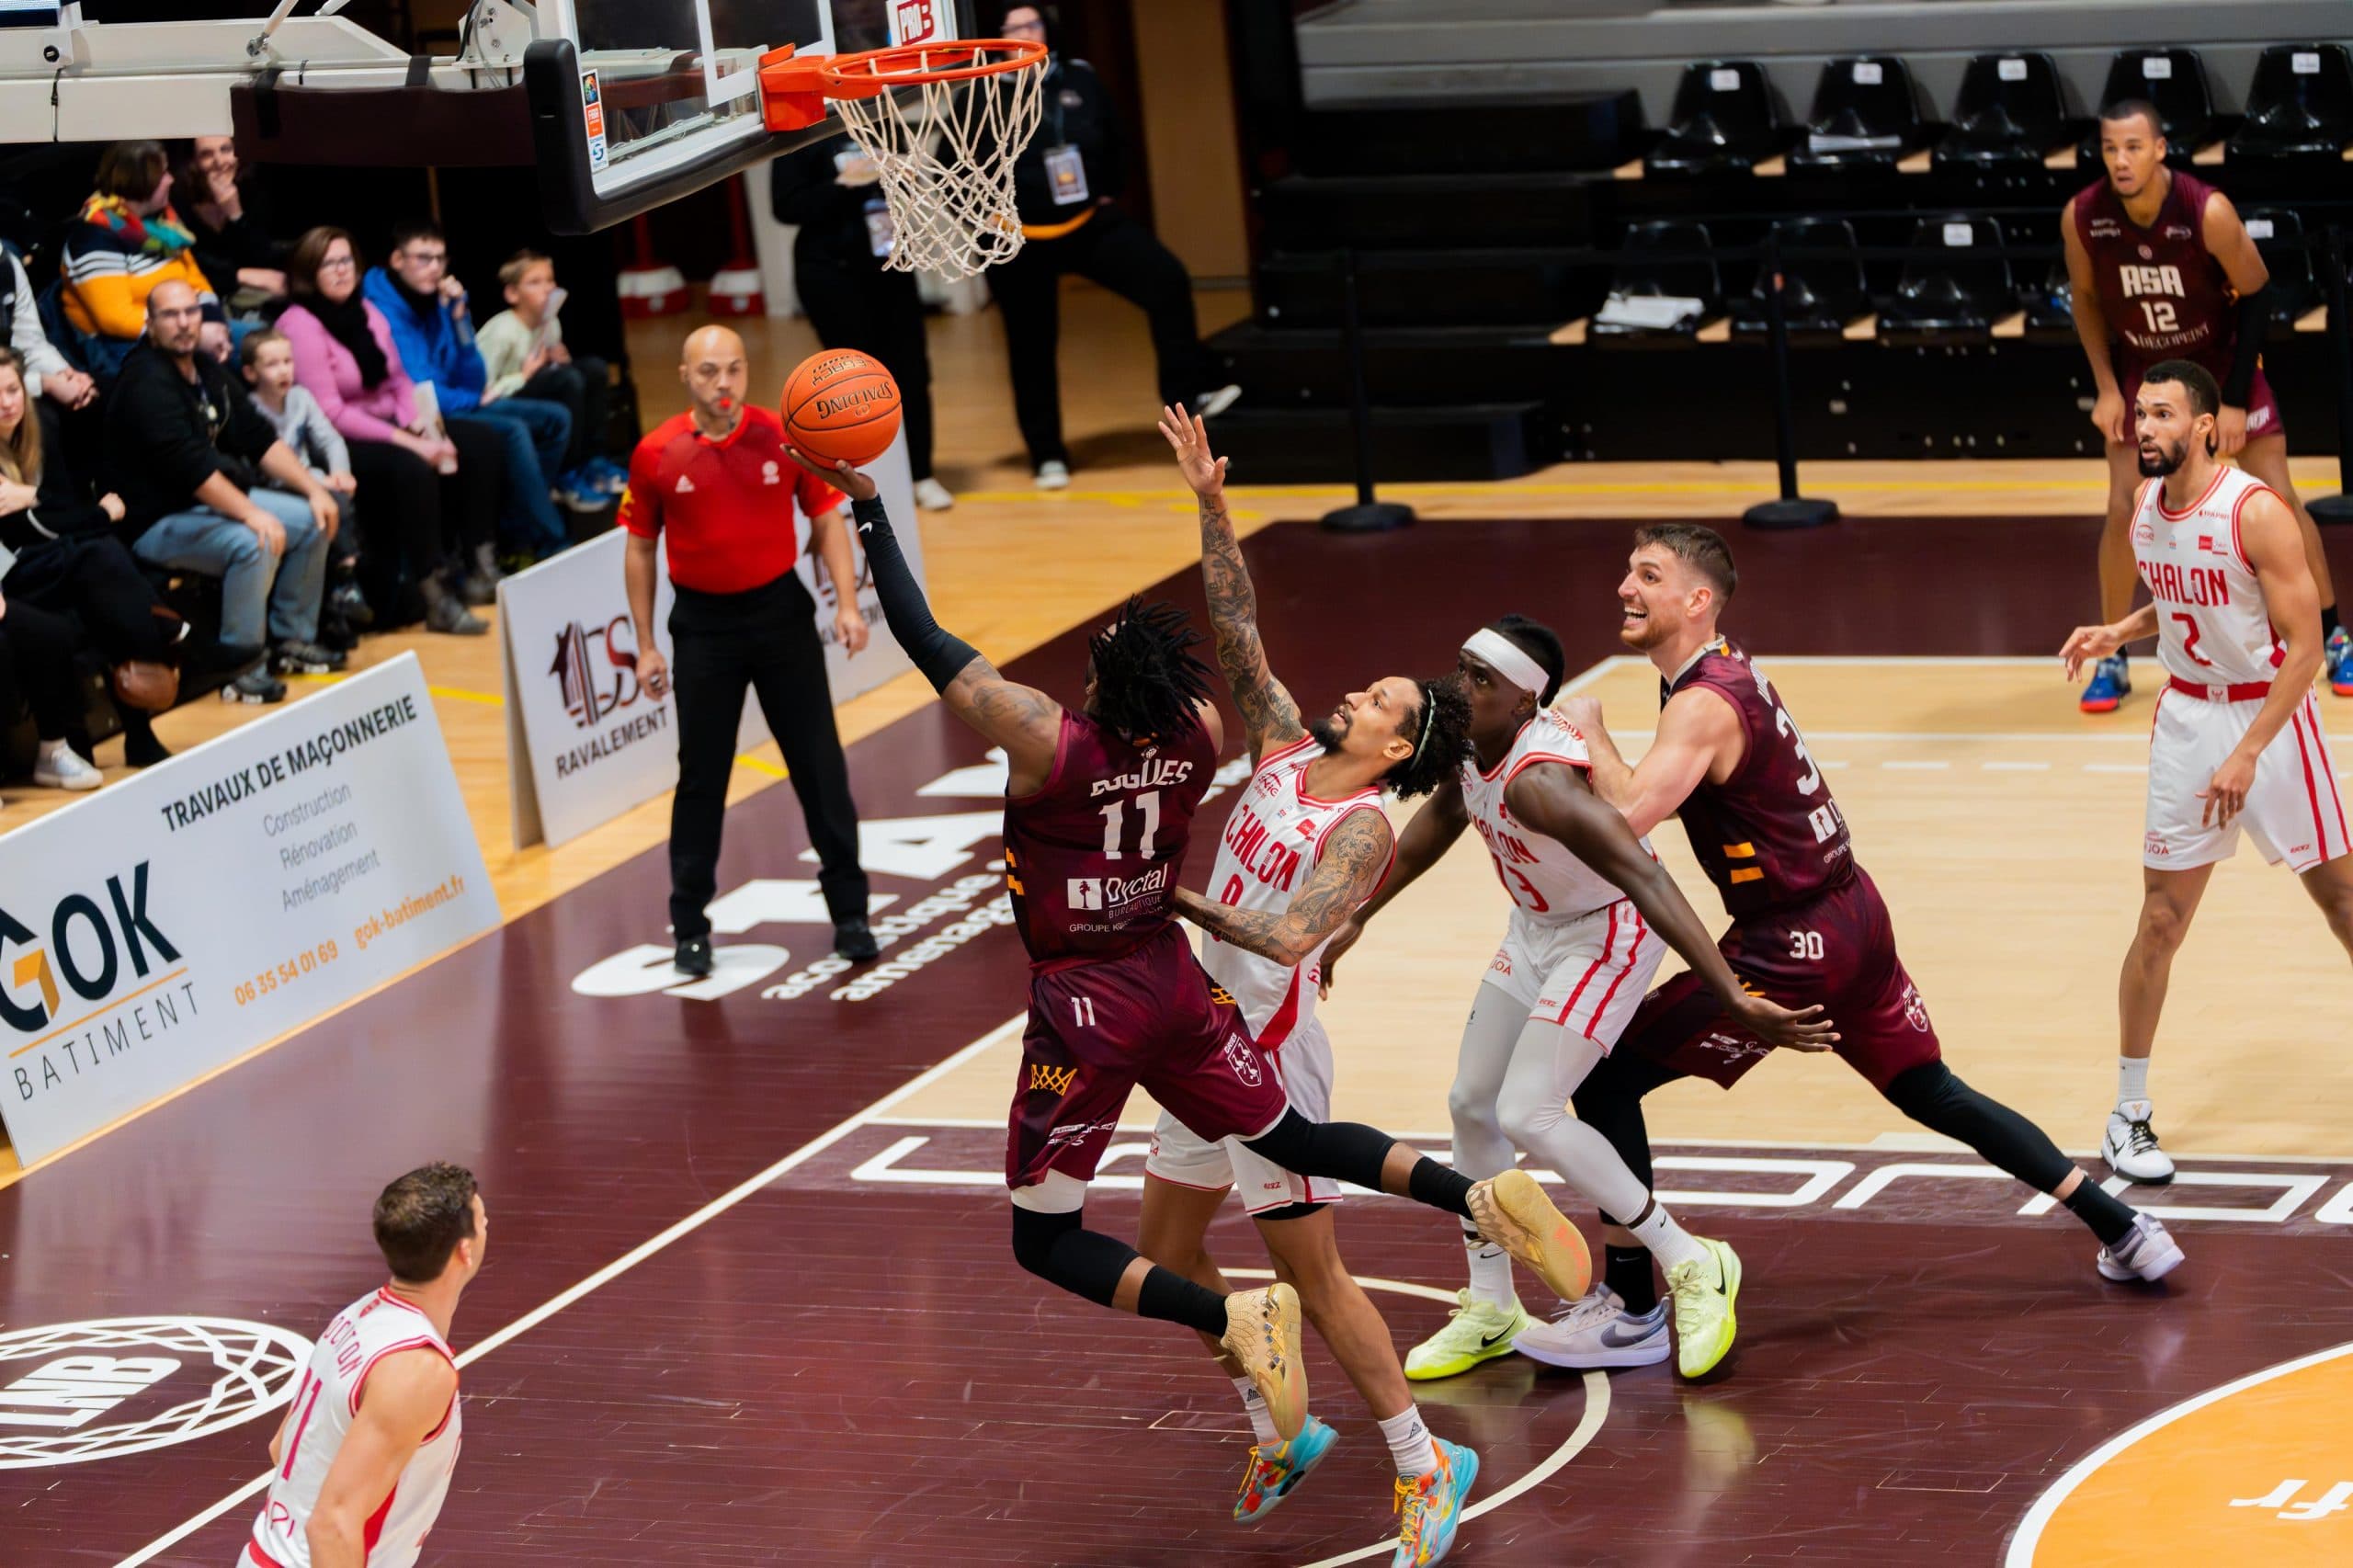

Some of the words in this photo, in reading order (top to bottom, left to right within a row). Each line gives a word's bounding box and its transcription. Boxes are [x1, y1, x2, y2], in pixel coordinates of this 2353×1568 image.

[2119, 265, 2186, 298] ASA
[2140, 301, 2179, 333] 12
[815, 381, 893, 419] SPALDING
[2139, 560, 2230, 607] CHALON
[2172, 612, 2211, 666] 2
[162, 767, 257, 832] TRAVAUX
[257, 756, 286, 789] DE
[287, 695, 418, 778] MAÇONNERIE
[556, 706, 667, 779] RAVALEMENT
[263, 782, 353, 837] Construction
[1098, 790, 1161, 860] 11
[279, 821, 358, 869] Rénovation
[280, 849, 381, 912] Aménagement
[1106, 862, 1168, 904] Dyctal
[1491, 851, 1550, 913] 13
[0, 860, 182, 1032] GOK
[233, 983, 256, 1006] 06
[256, 971, 278, 995] 35
[278, 962, 300, 987] 54
[300, 952, 318, 977] 01
[318, 941, 338, 966] 69
[353, 876, 466, 950] gok-batiment.fr
[1069, 923, 1111, 933] GROUPE
[1790, 931, 1824, 960] 30
[1071, 996, 1097, 1028] 11
[14, 982, 200, 1102] BATIMENT
[0, 1355, 182, 1428] LMB
